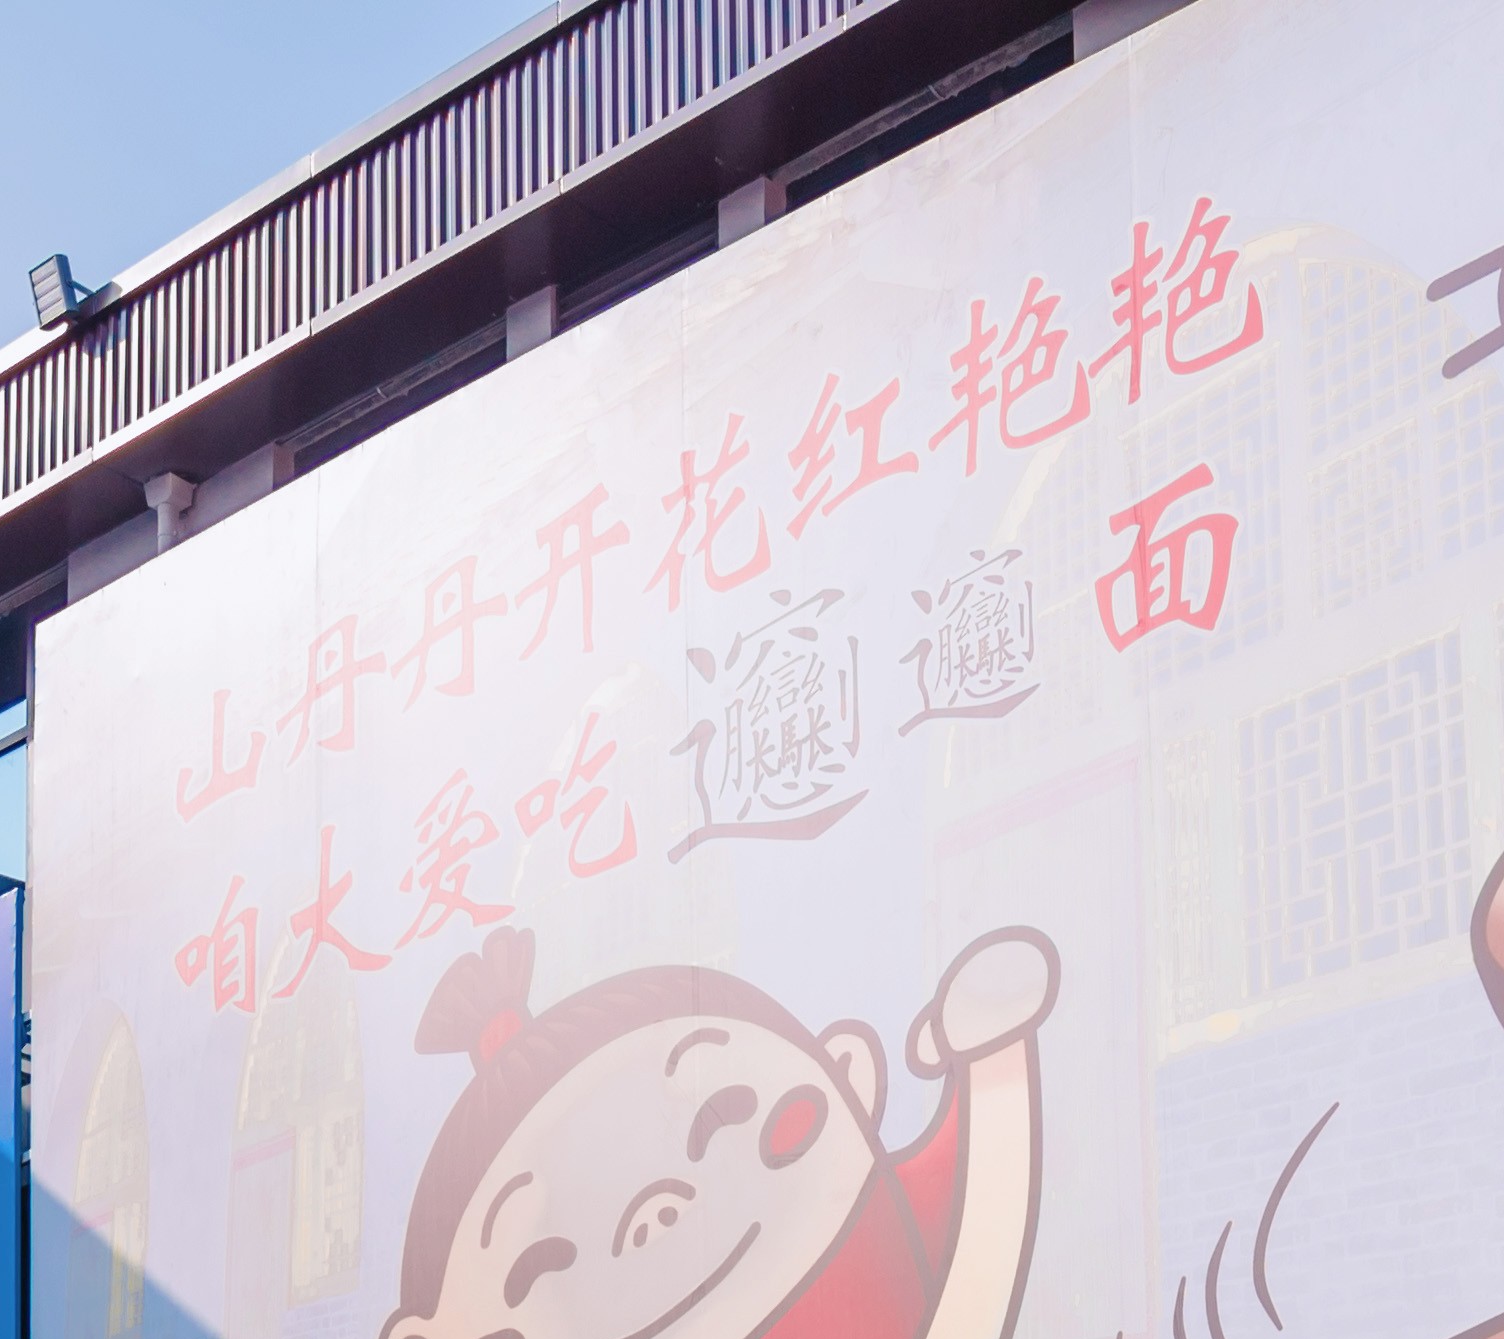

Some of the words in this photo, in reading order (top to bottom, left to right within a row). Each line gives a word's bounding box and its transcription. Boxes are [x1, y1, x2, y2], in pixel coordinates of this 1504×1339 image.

[175, 198, 1264, 824] 山丹丹开花红艳艳
